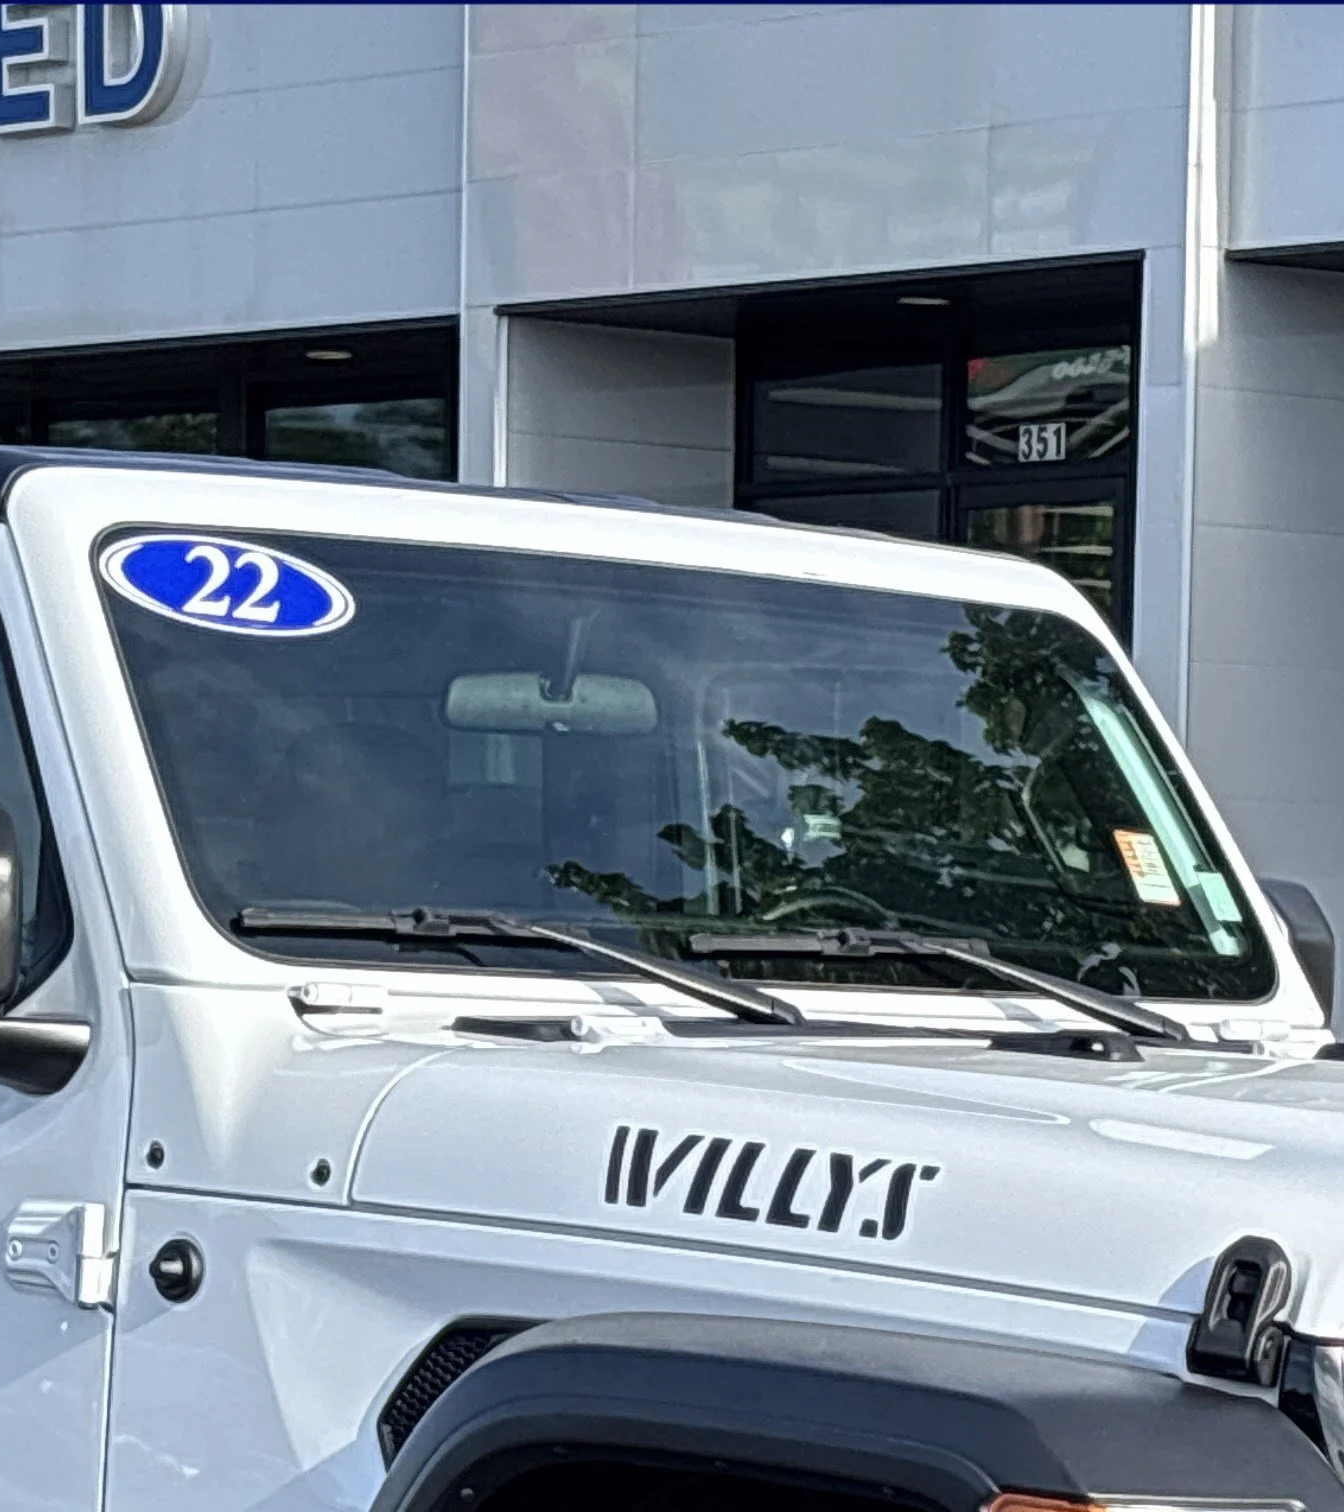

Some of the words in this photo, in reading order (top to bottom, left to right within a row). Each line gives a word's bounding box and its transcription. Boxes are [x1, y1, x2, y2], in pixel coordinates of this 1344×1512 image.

[1021, 425, 1063, 460] 351
[182, 545, 280, 623] 22
[604, 1125, 941, 1241] WILLYS
